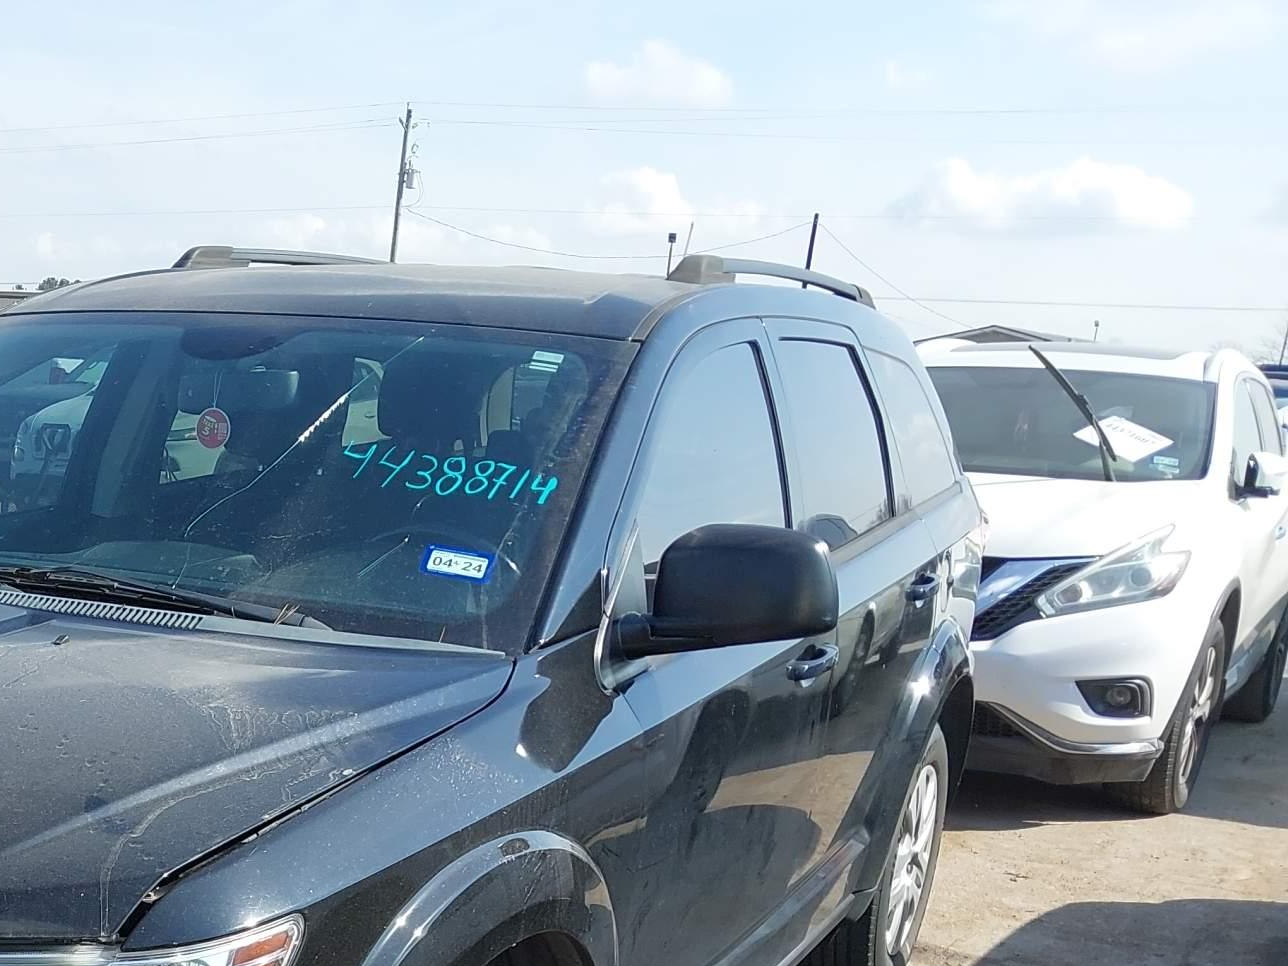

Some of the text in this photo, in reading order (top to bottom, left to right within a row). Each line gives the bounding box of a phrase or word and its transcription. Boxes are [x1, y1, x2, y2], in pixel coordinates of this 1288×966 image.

[343, 440, 558, 505] 44388714
[432, 556, 453, 568] 04
[461, 561, 483, 574] 24
